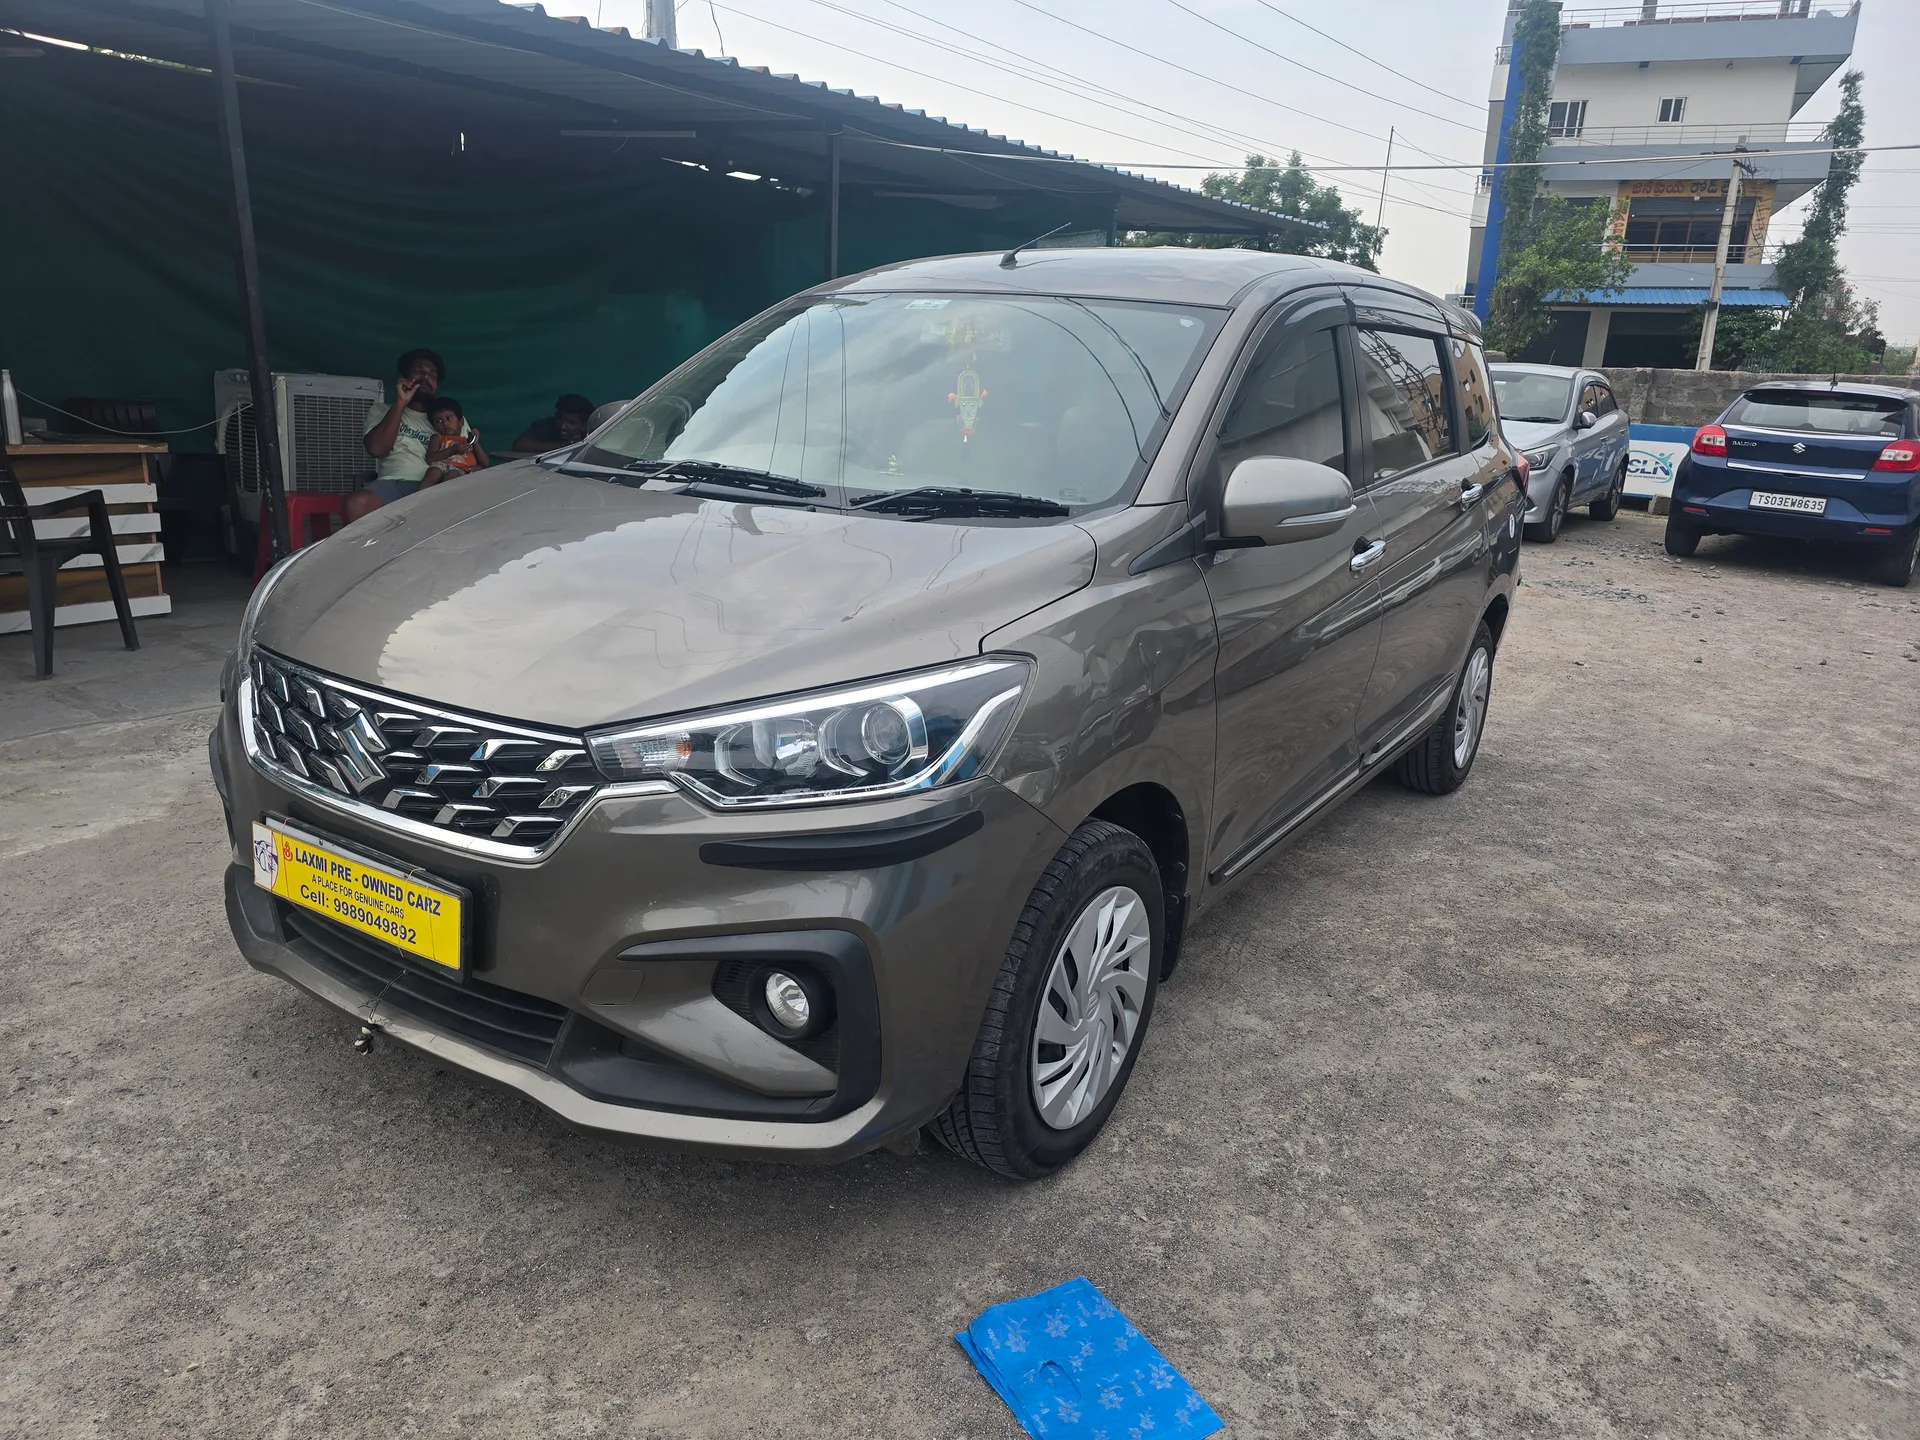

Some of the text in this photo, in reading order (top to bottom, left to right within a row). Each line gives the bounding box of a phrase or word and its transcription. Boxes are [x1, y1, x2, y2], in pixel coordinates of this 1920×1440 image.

[1758, 494, 1824, 511] TS03EW8635
[295, 847, 327, 873] LAXMI
[331, 861, 352, 883] PRE
[361, 873, 404, 902] OWNED
[407, 890, 441, 916] CARZ
[312, 874, 405, 919] A PLACE FOR GENUINE CARS
[300, 884, 417, 945] Cell: 9989049892
